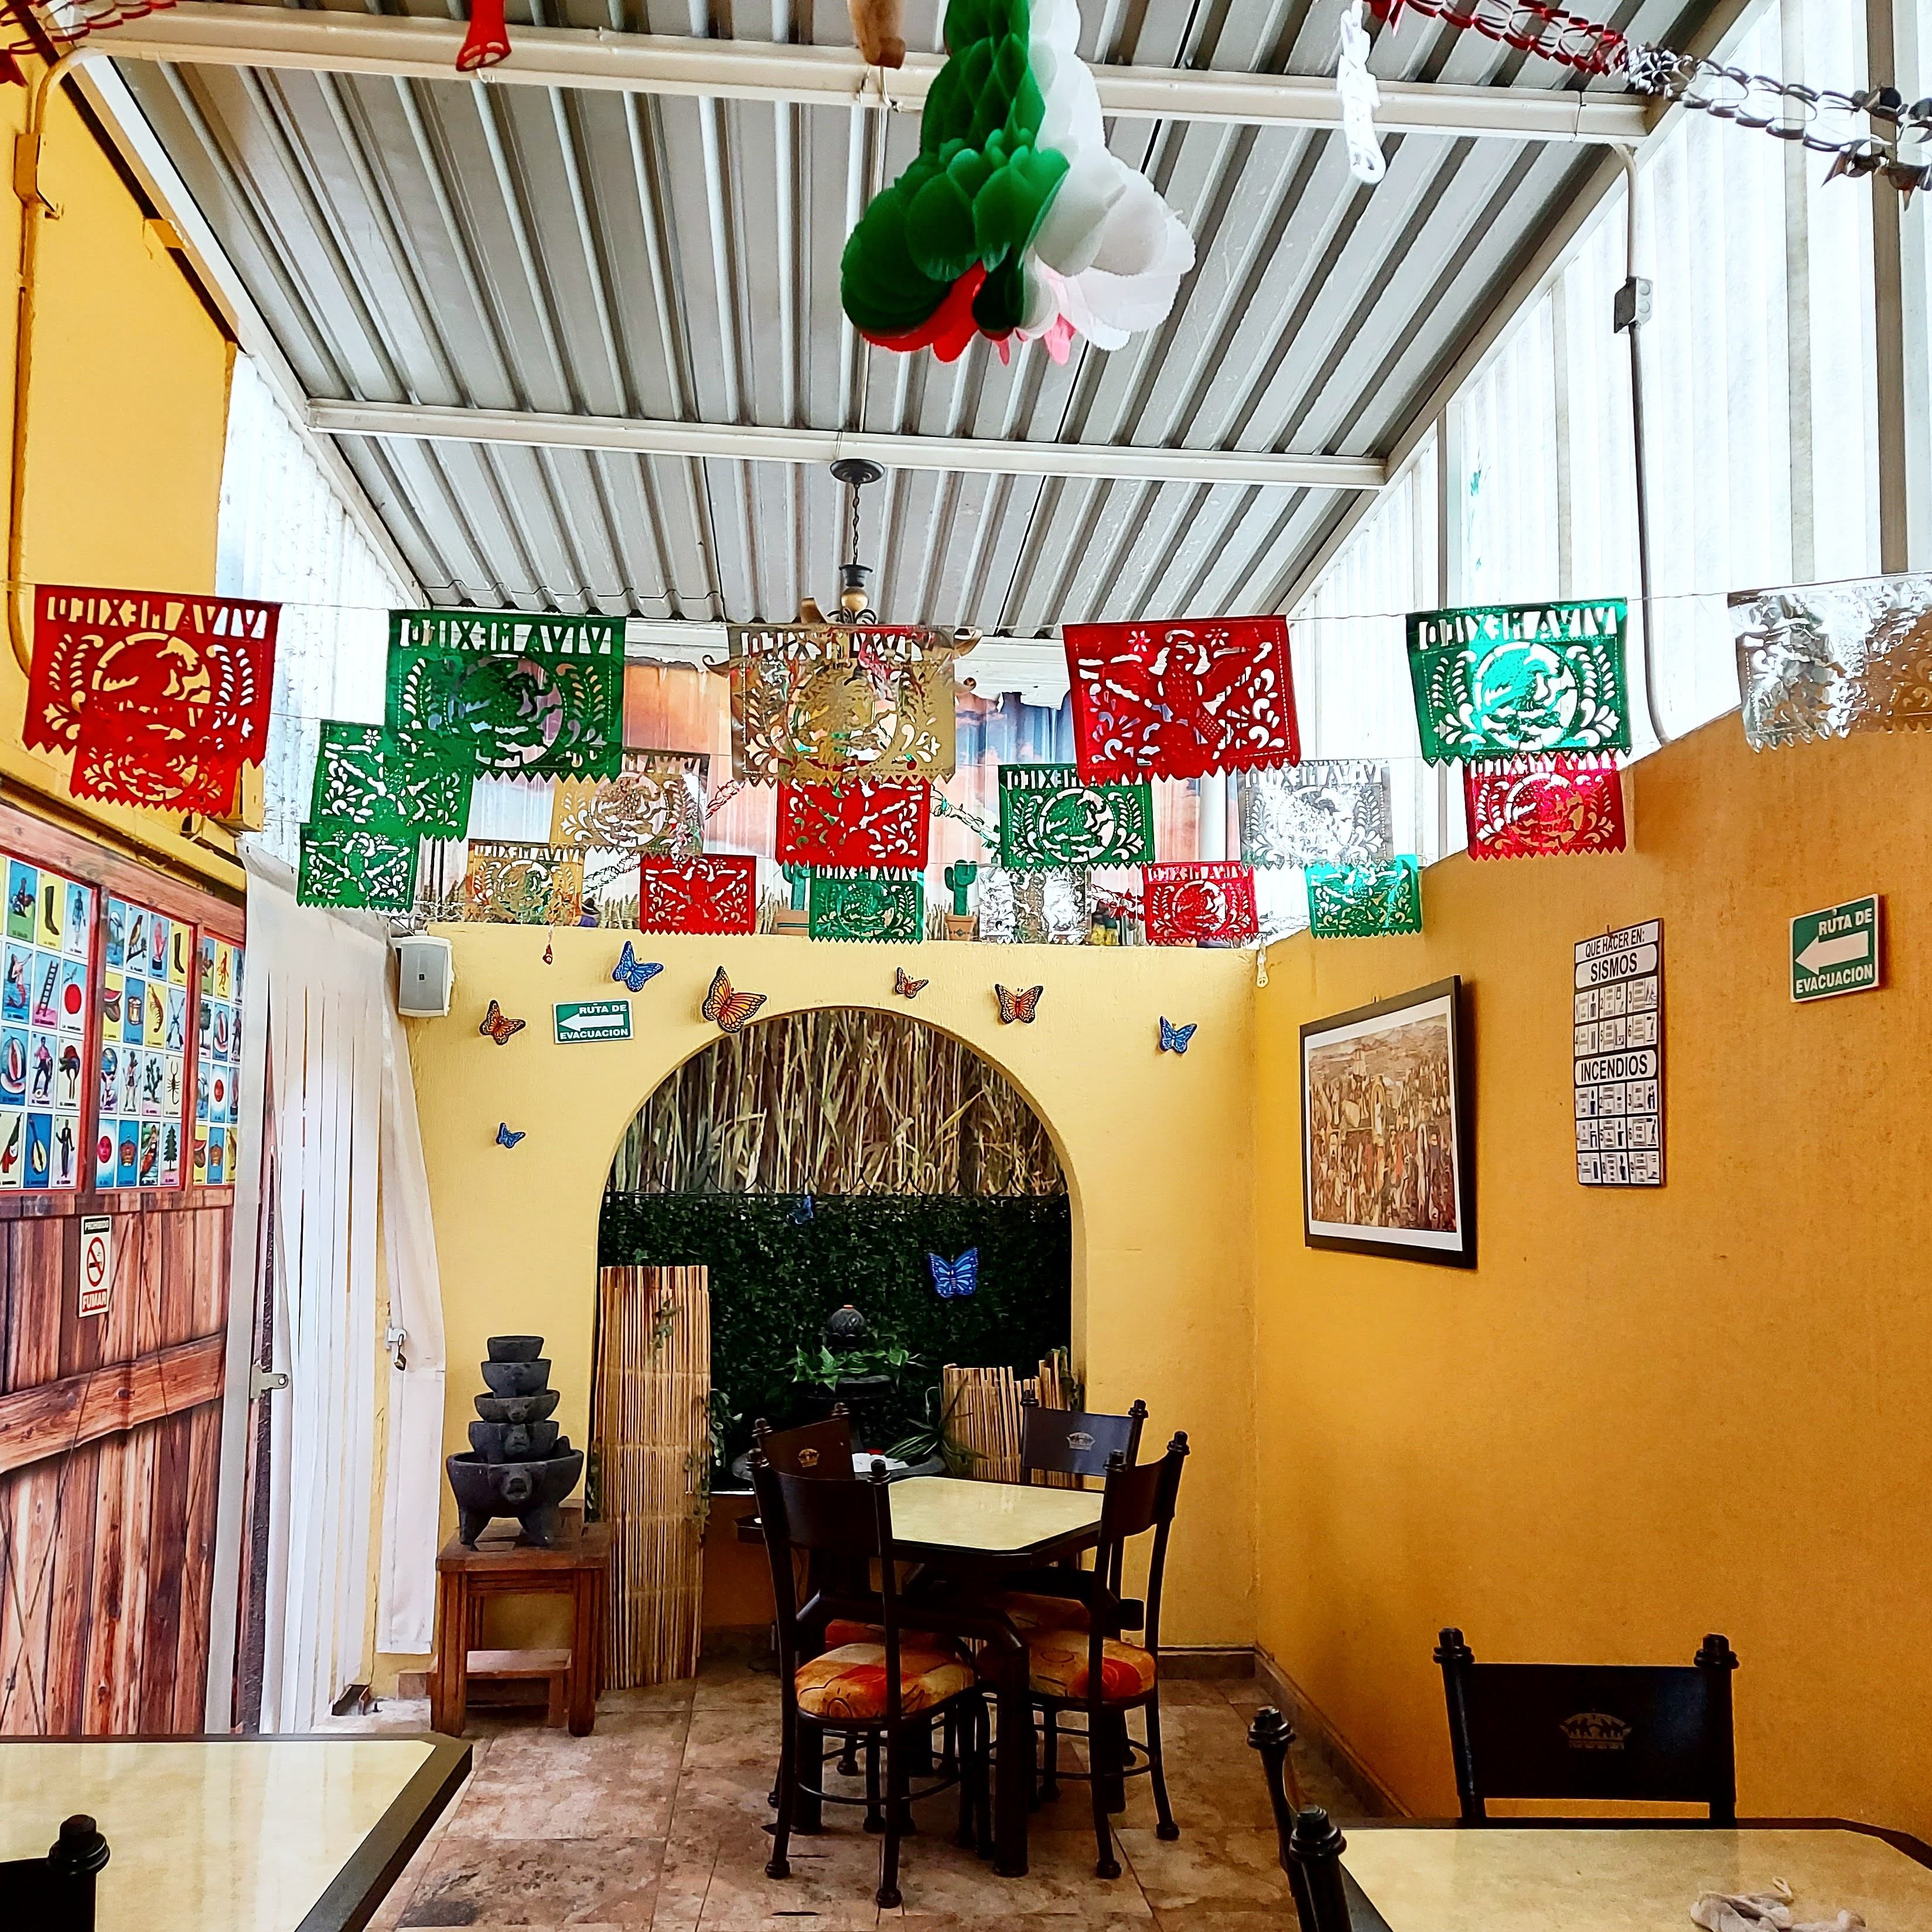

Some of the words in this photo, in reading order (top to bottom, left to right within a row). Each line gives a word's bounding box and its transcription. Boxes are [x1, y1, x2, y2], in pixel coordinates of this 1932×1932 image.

[1818, 914, 1852, 936] RUTA
[1855, 908, 1872, 926] DE
[1585, 940, 1600, 957] QUE
[1602, 931, 1629, 953] HACER
[1631, 928, 1645, 945] EN:
[1590, 953, 1637, 982] SISMOS
[1796, 964, 1873, 994] EVACUACION
[579, 1005, 609, 1014] RUTA
[559, 1028, 629, 1040] EVACUACION
[1581, 1054, 1647, 1082] INCENDIOS
[83, 1291, 107, 1310] FUMAR
